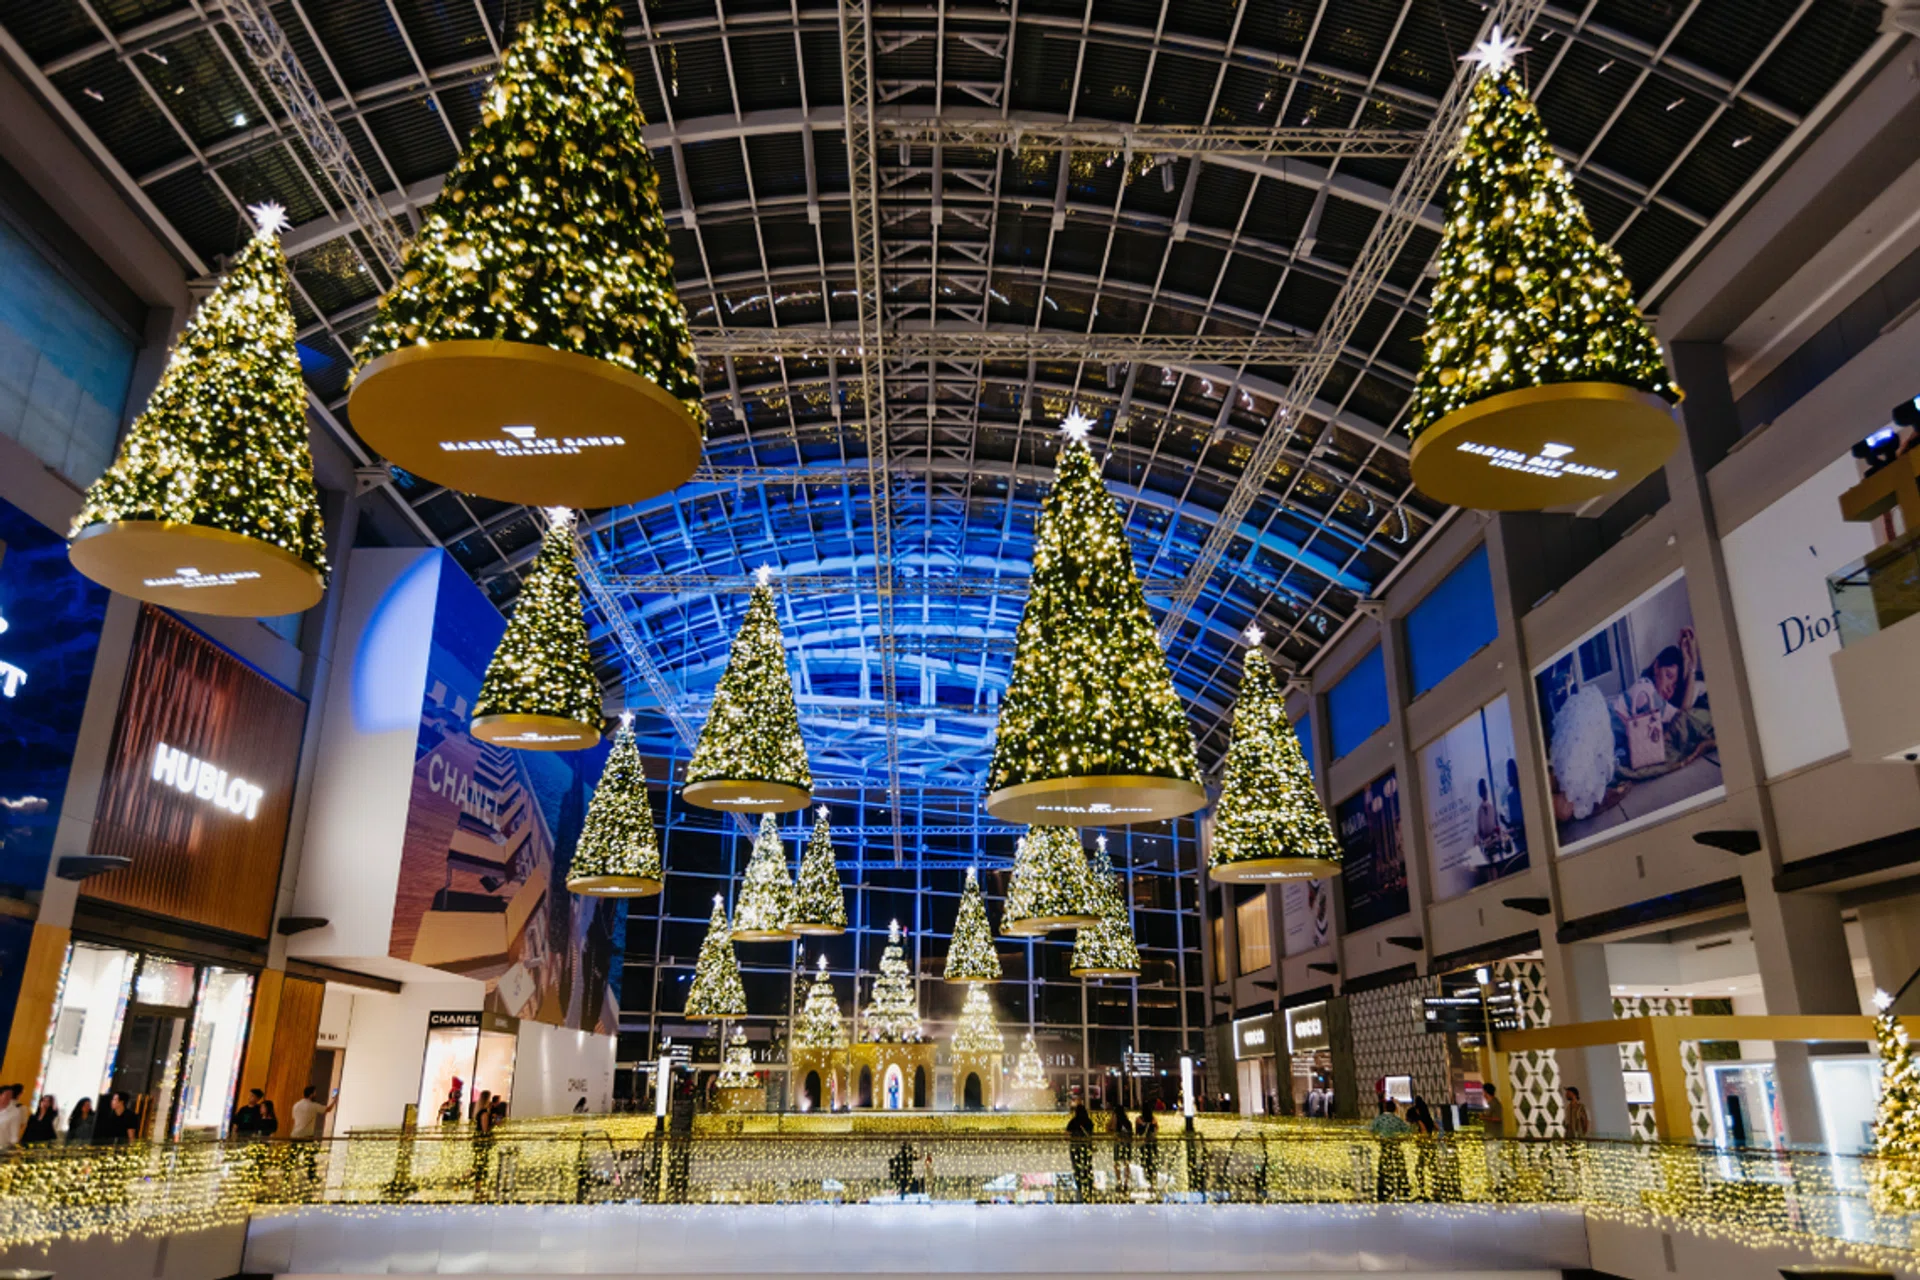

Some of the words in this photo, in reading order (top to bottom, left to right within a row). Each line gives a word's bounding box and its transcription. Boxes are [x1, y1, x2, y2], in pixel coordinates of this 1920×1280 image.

[439, 439, 518, 451] MARINA
[521, 438, 558, 448] BAY
[562, 436, 625, 446] SANDS
[1777, 609, 1841, 657] Dior
[152, 741, 265, 821] HUBLOT
[428, 753, 502, 831] CHANEL
[431, 1014, 480, 1025] CHANEL
